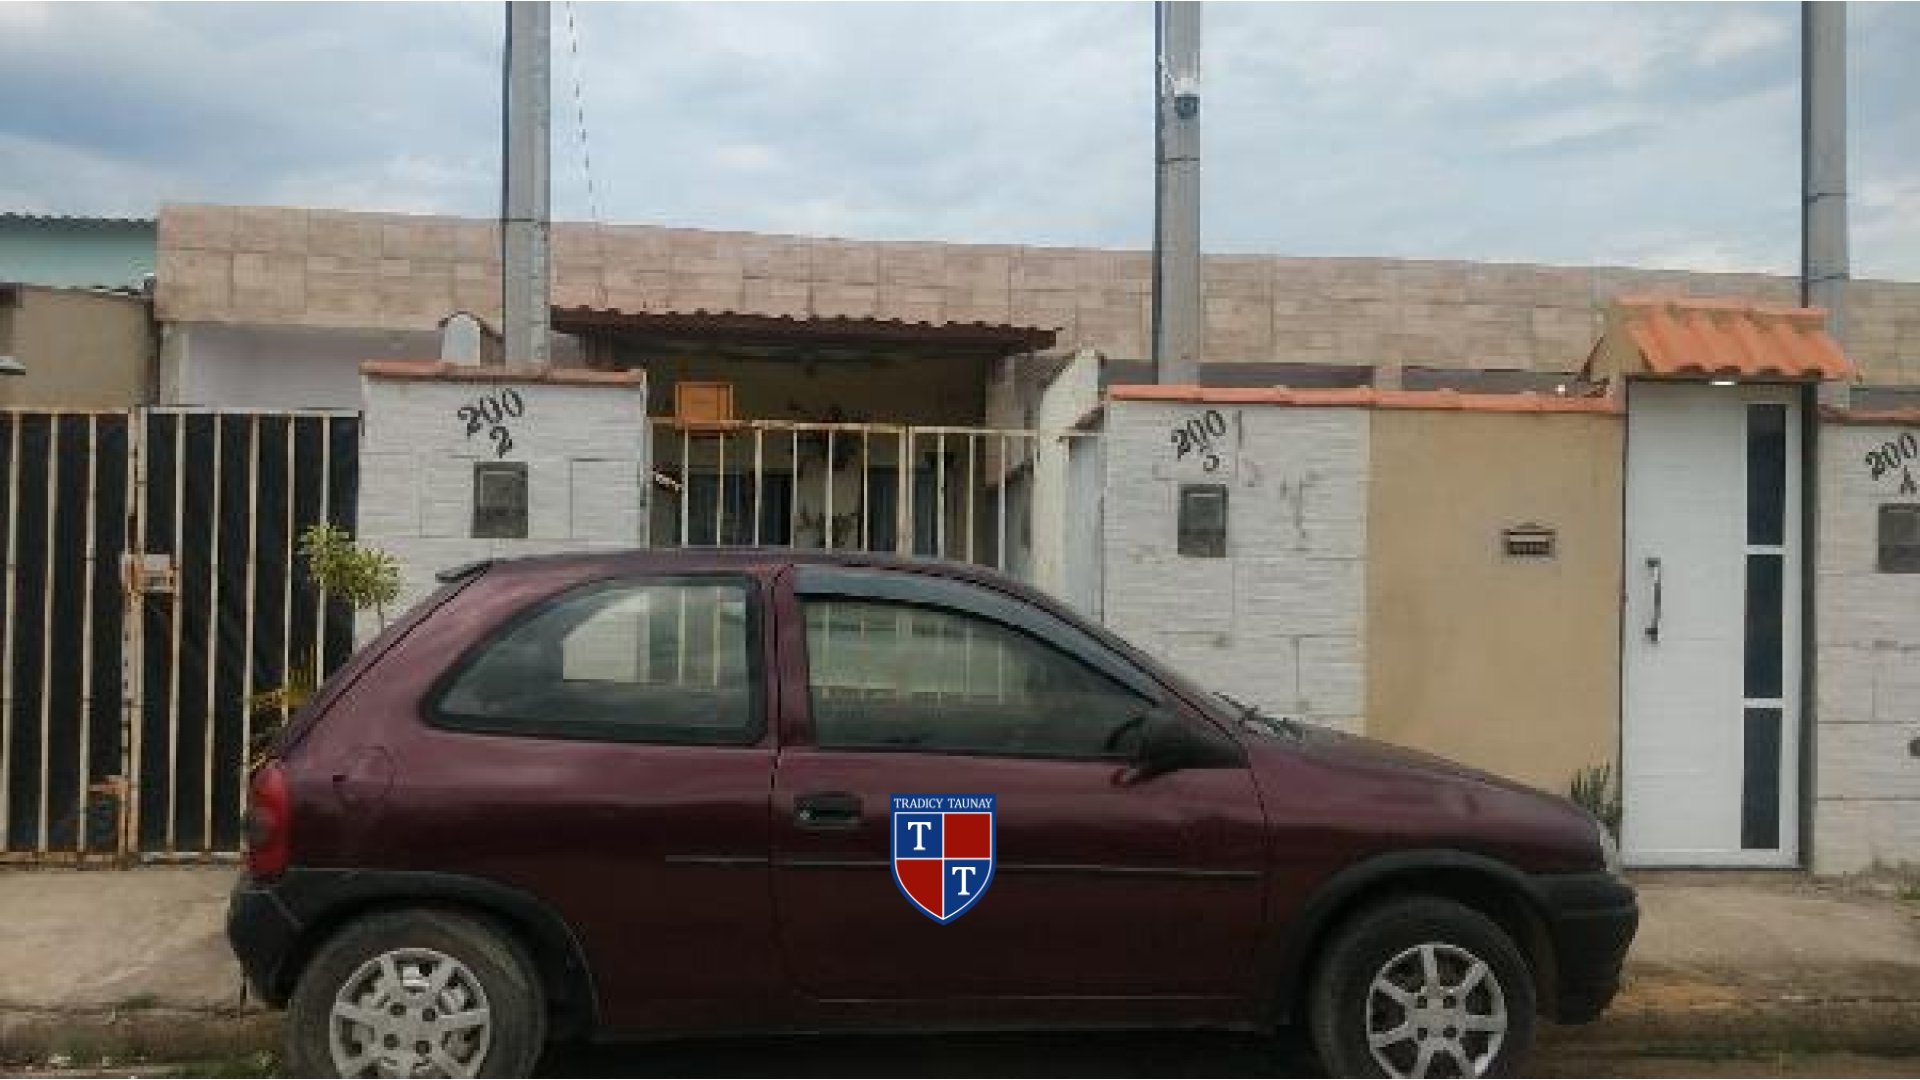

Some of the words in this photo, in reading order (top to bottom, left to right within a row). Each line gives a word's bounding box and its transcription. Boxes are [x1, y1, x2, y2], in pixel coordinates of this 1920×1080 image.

[457, 387, 524, 437] 200
[1171, 410, 1227, 462] 200
[489, 425, 513, 459] 2
[1865, 432, 1918, 481] 200
